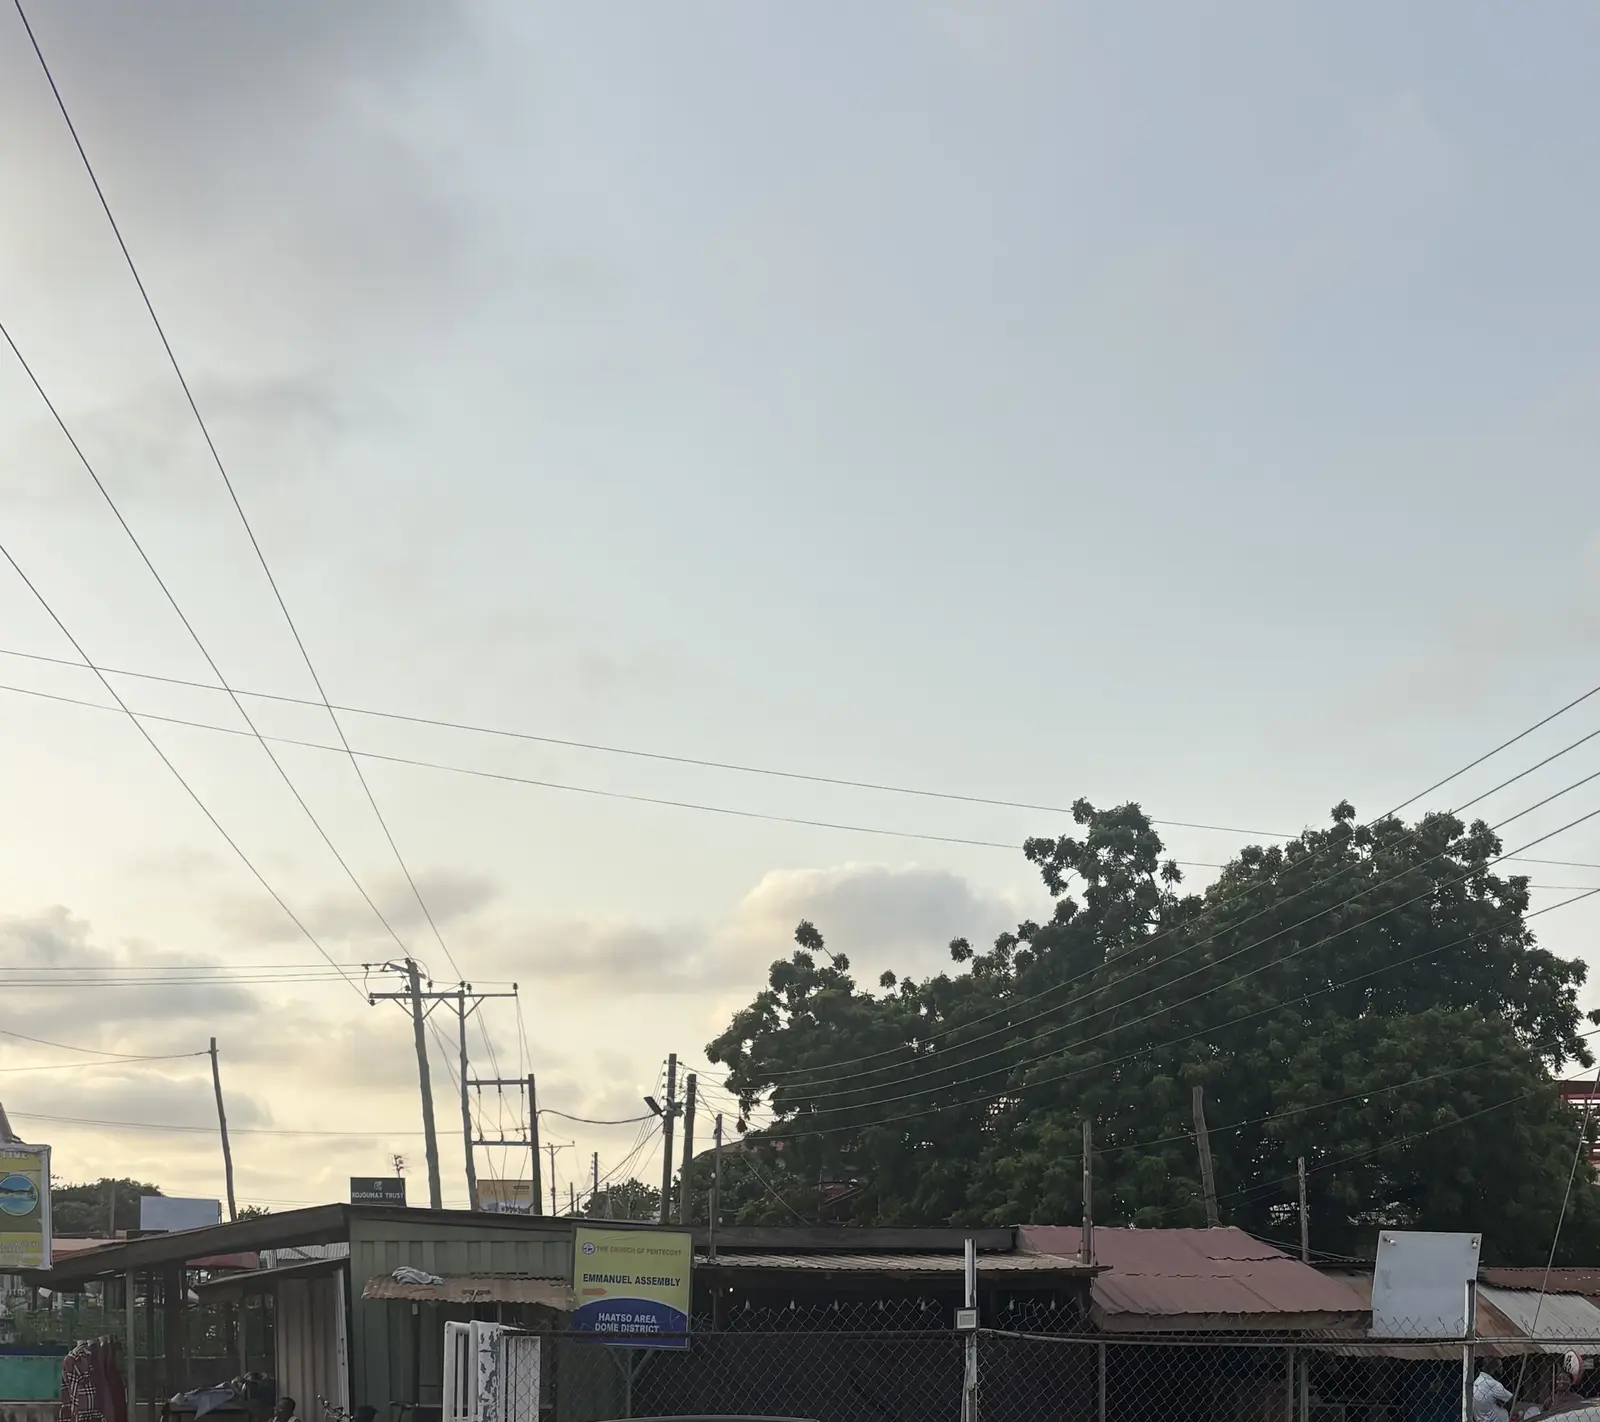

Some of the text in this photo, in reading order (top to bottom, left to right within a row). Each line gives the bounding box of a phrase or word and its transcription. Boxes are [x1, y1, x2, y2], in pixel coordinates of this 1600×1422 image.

[596, 1245, 609, 1253] THE
[610, 1246, 635, 1254] CHURCH
[646, 1248, 682, 1256] PENTECOST
[583, 1273, 681, 1287] EMMANUEL ASSEMBLY
[598, 1312, 657, 1324] HAATSO AREA
[595, 1322, 660, 1333] DOME DISTRICT
